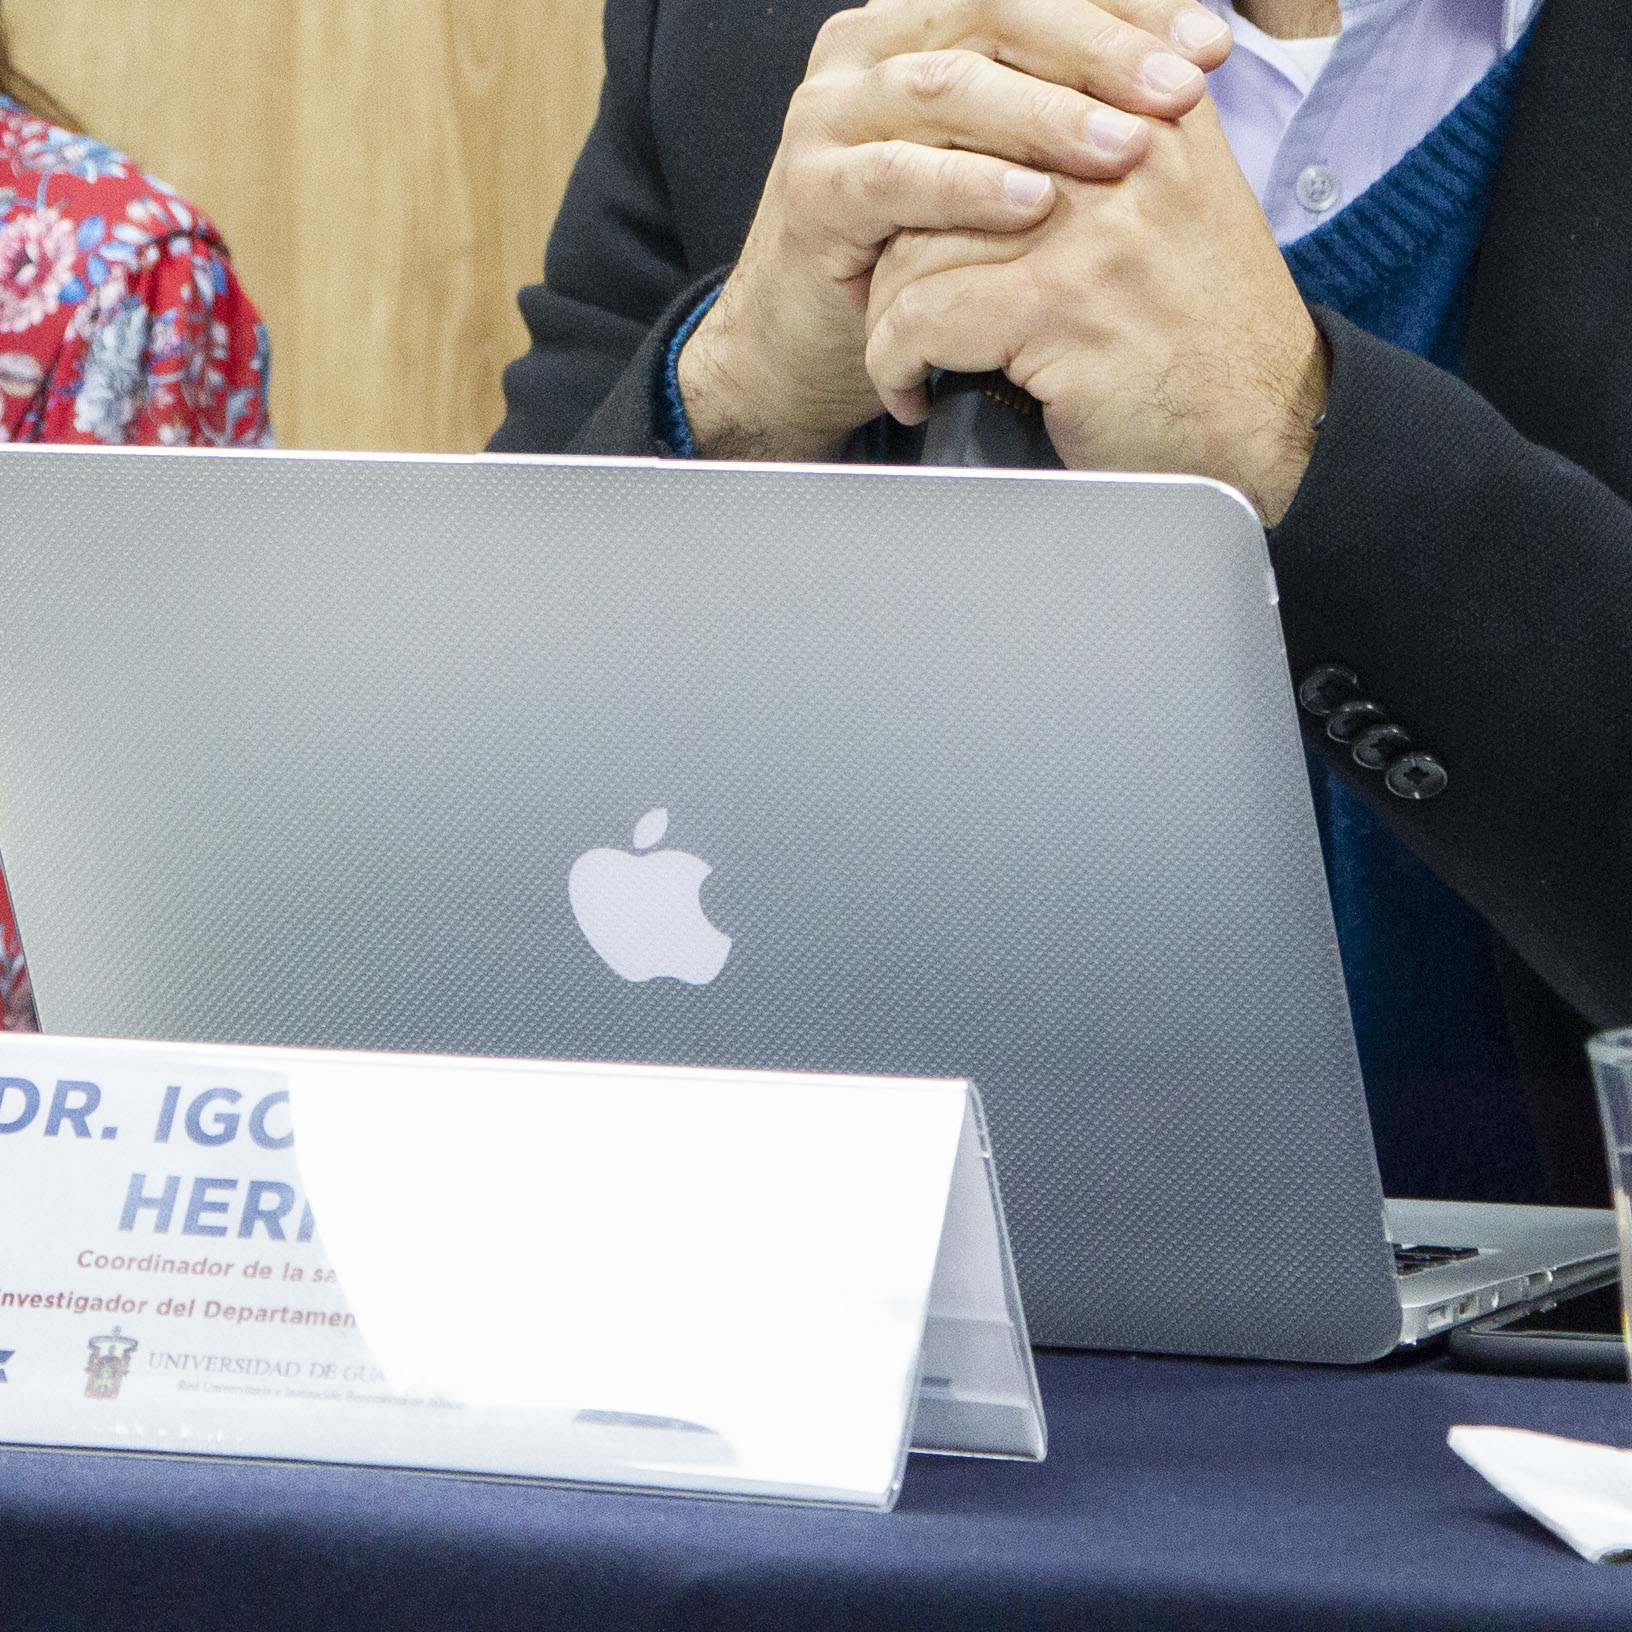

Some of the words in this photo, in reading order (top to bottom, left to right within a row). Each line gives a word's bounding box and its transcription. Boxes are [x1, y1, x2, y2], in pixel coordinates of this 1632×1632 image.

[76, 1249, 235, 1279] Coordinador
[242, 1260, 273, 1281] de
[282, 1262, 304, 1283] la
[156, 1298, 196, 1318] del
[148, 1351, 302, 1378] UNIVERSIDAD
[309, 1361, 339, 1380] DE
